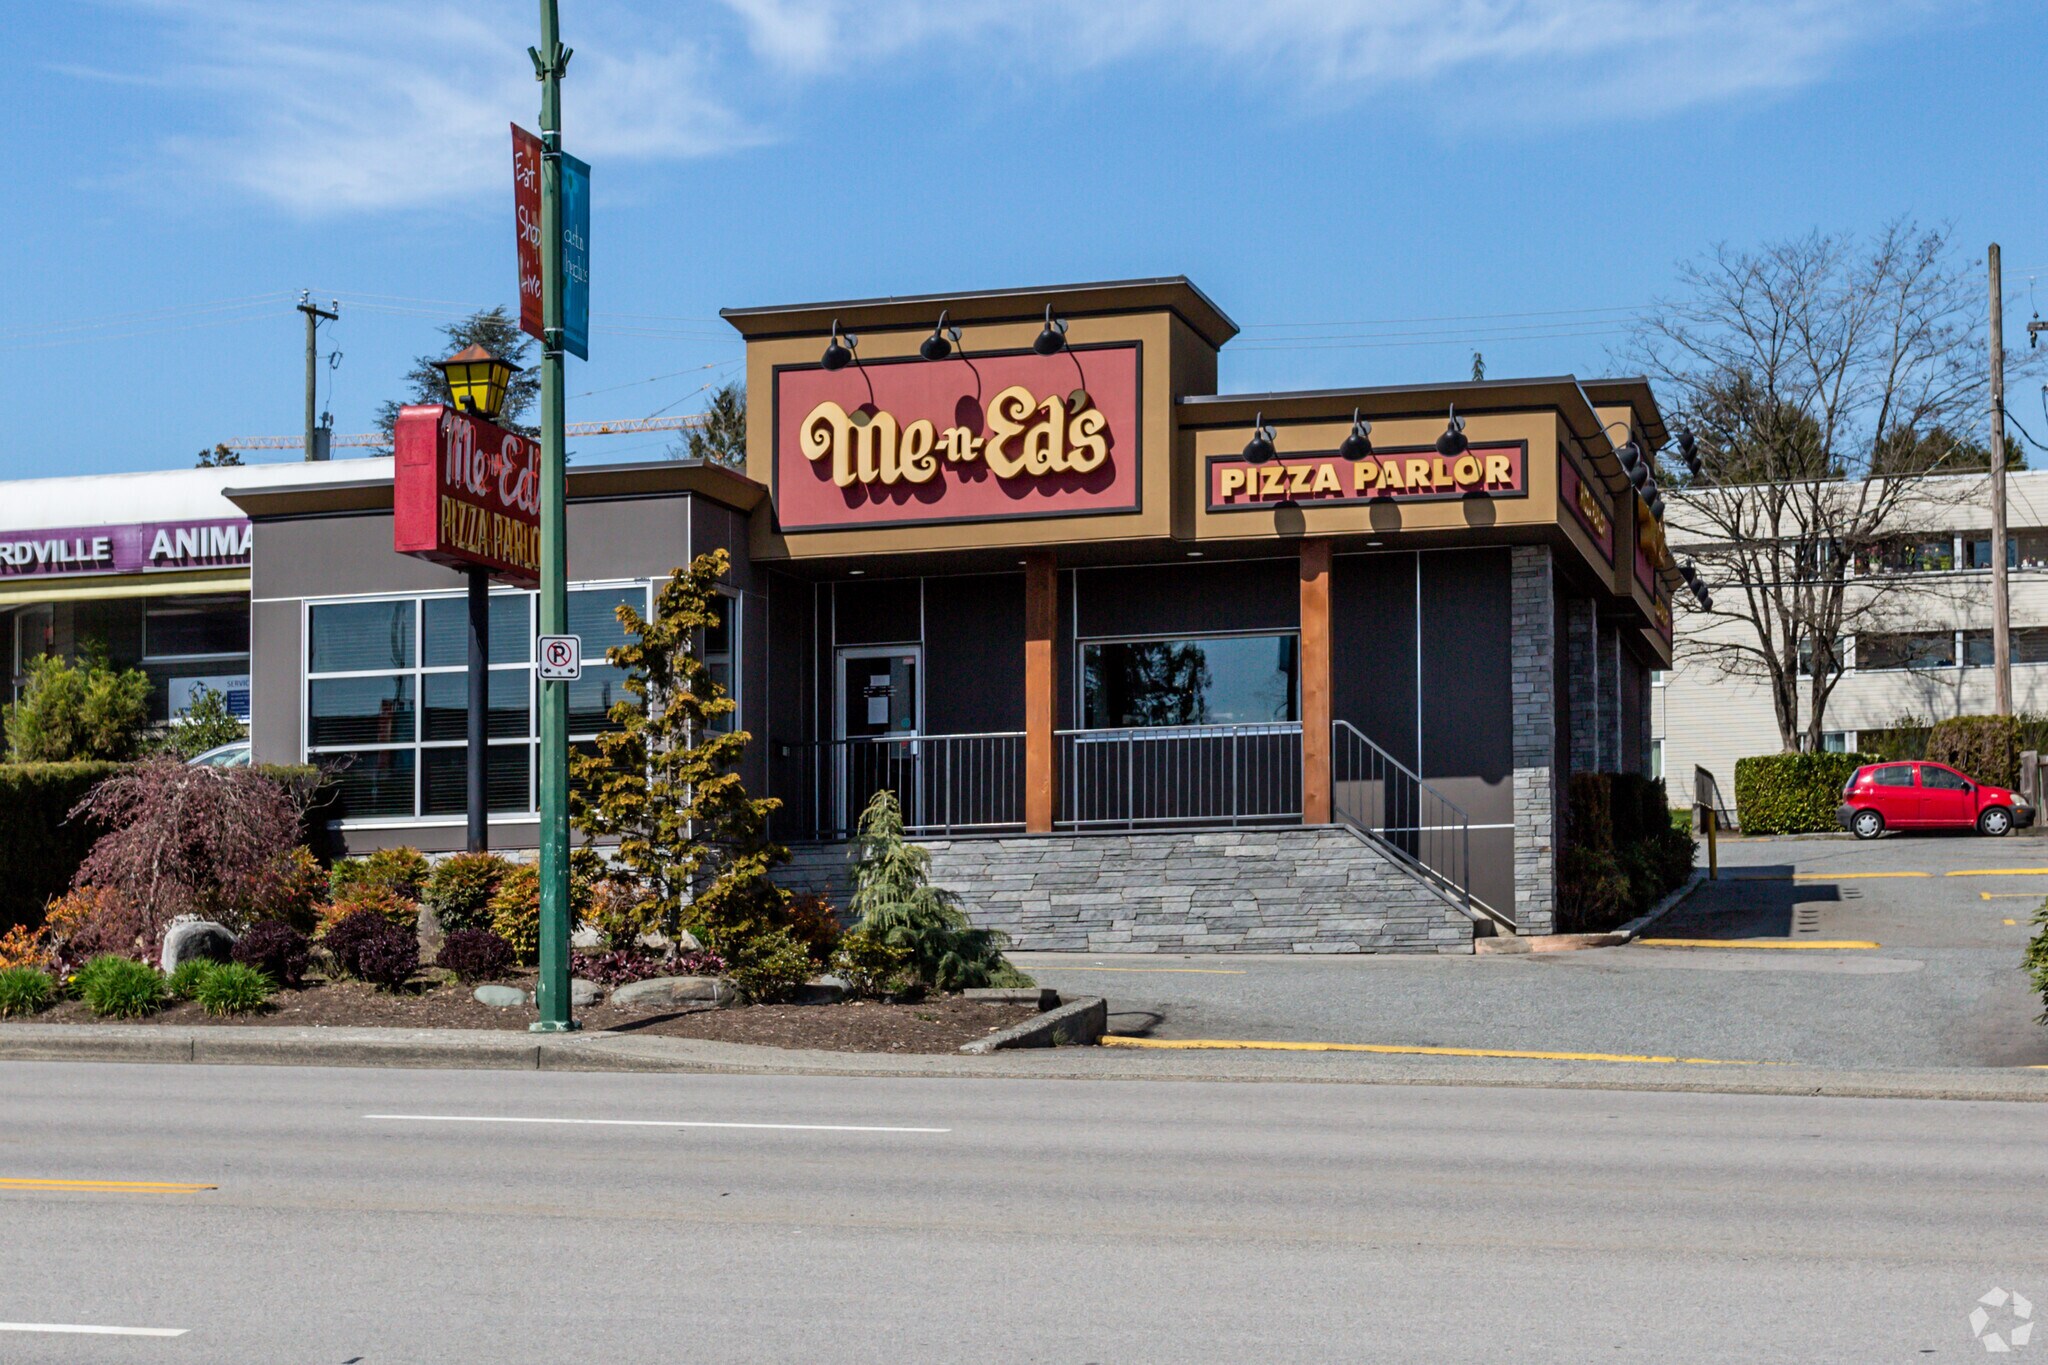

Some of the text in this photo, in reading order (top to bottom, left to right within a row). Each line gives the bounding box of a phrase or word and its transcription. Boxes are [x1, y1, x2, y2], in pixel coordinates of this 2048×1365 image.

[515, 152, 537, 194] Eat.
[1221, 455, 1512, 497] PIZZA PARLOR
[441, 494, 491, 557] PIZZA
